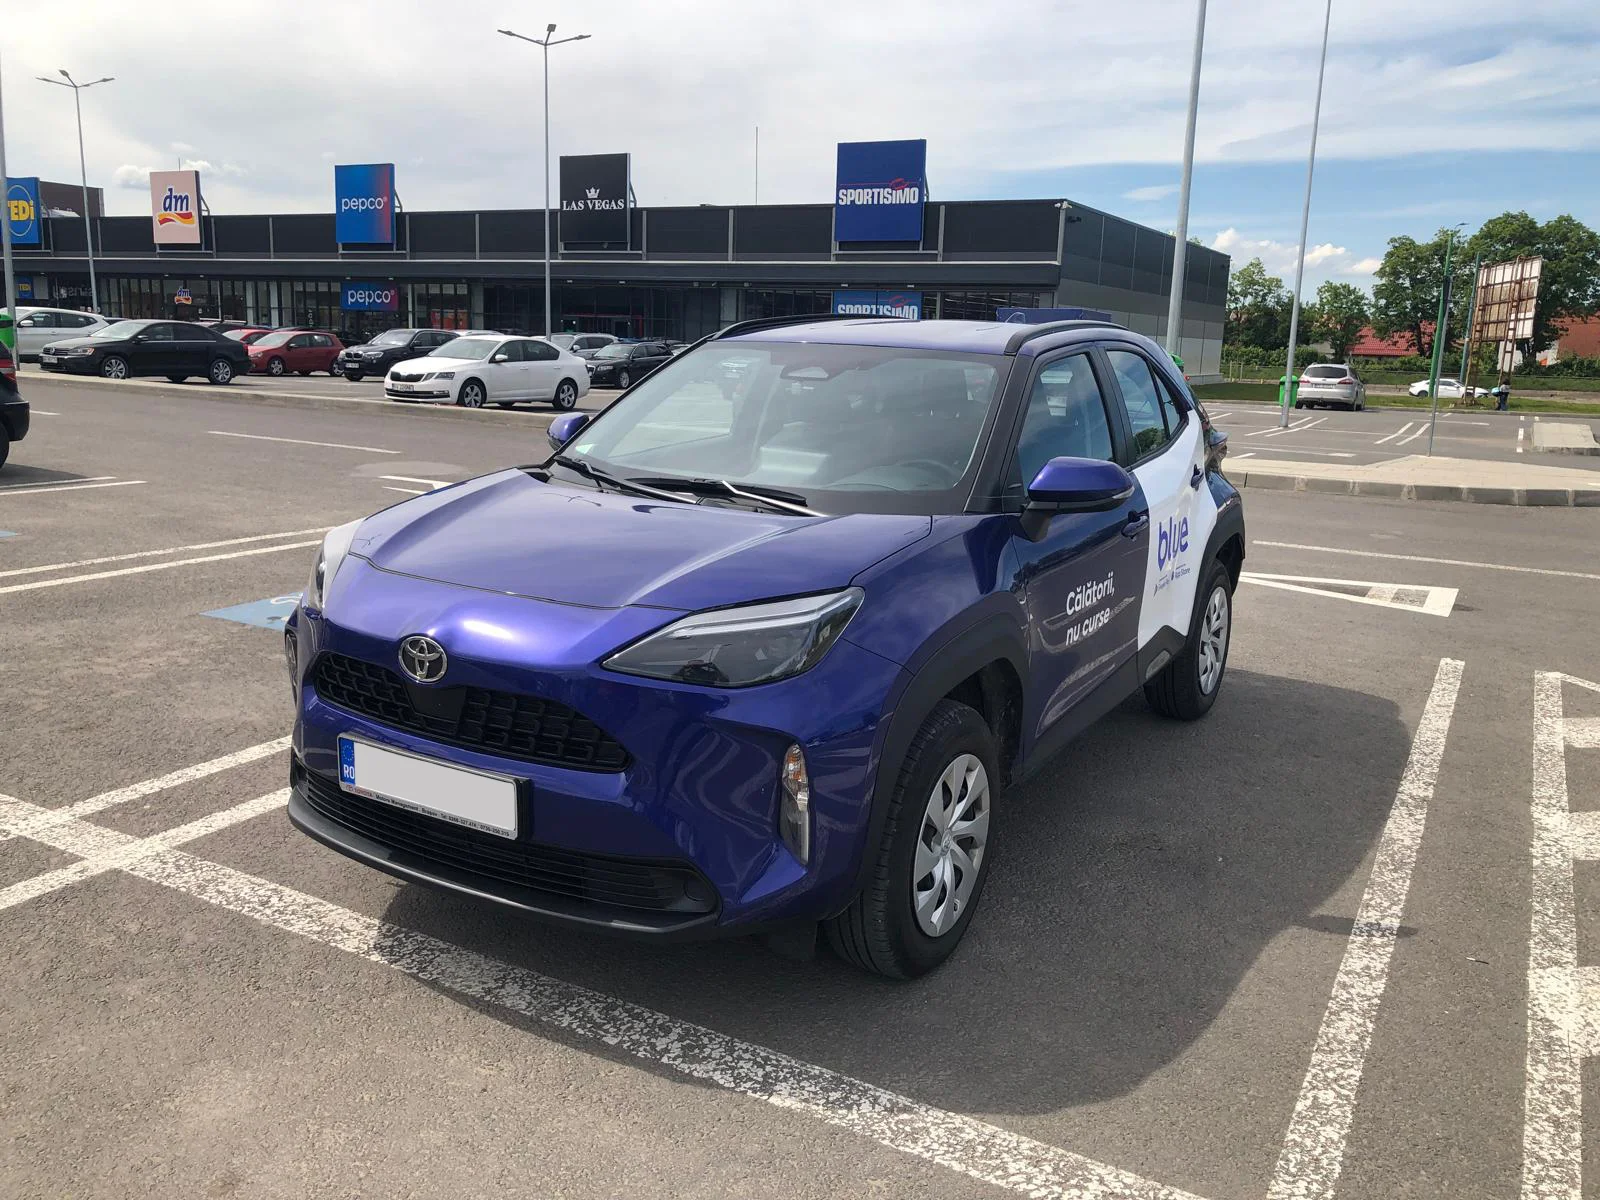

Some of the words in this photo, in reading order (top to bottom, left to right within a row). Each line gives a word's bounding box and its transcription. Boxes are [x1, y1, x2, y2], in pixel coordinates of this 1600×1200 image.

[162, 186, 190, 213] dm
[341, 197, 384, 212] pepco
[838, 187, 919, 205] SPORTISIMO
[562, 200, 585, 211] LAS
[586, 199, 625, 211] VEGAS
[347, 290, 391, 305] pepco
[1157, 516, 1189, 572] blue
[1065, 625, 1080, 646] nu
[1082, 607, 1111, 638] curse
[343, 763, 355, 780] RO
